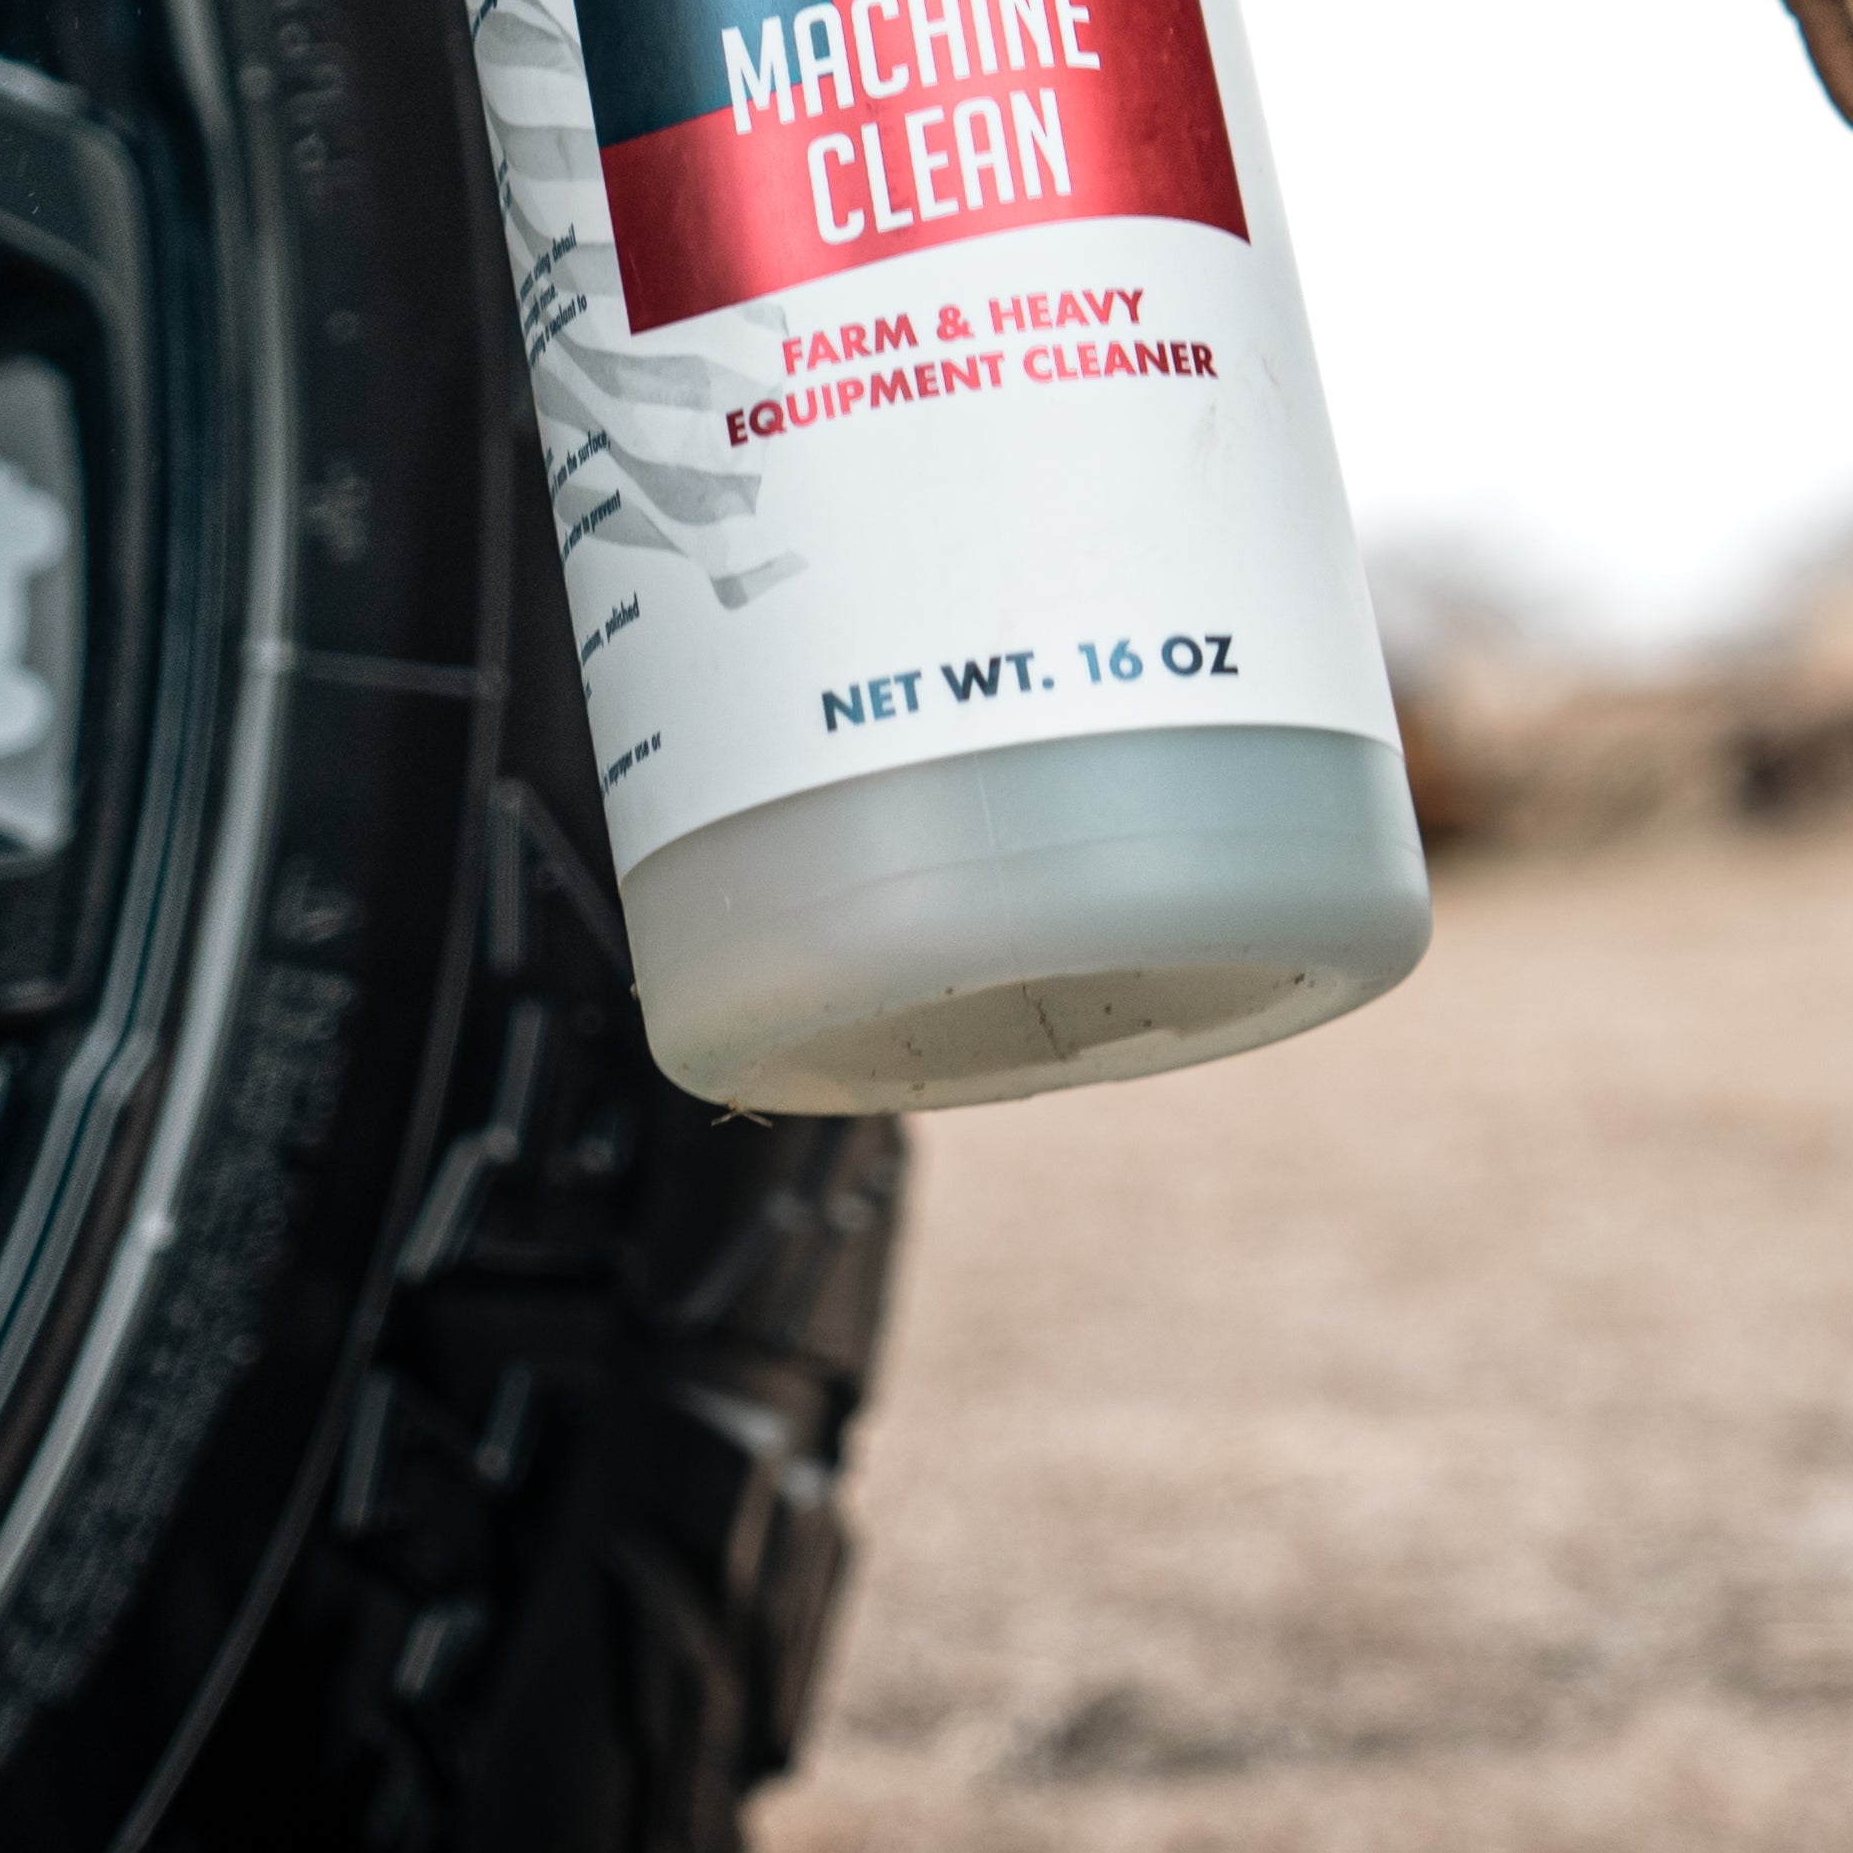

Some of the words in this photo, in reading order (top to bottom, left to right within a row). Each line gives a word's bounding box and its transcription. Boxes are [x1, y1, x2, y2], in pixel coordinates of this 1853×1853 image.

[806, 87, 1073, 247] CLEAN
[551, 221, 578, 264] detail
[576, 293, 589, 316] to
[782, 313, 919, 376] FARM
[935, 304, 976, 344] &
[988, 287, 1146, 335] HEAVY
[725, 351, 1006, 448] EQUIPMENT
[1022, 339, 1220, 384] CLEANER
[577, 428, 612, 468] surface,
[589, 486, 622, 534] prevent
[604, 590, 640, 645] polished
[820, 670, 922, 733] NET
[940, 650, 1056, 704] WT.
[1077, 637, 1144, 684] 16
[1160, 634, 1239, 678] OZ
[634, 736, 650, 763] use
[651, 729, 661, 753] or
